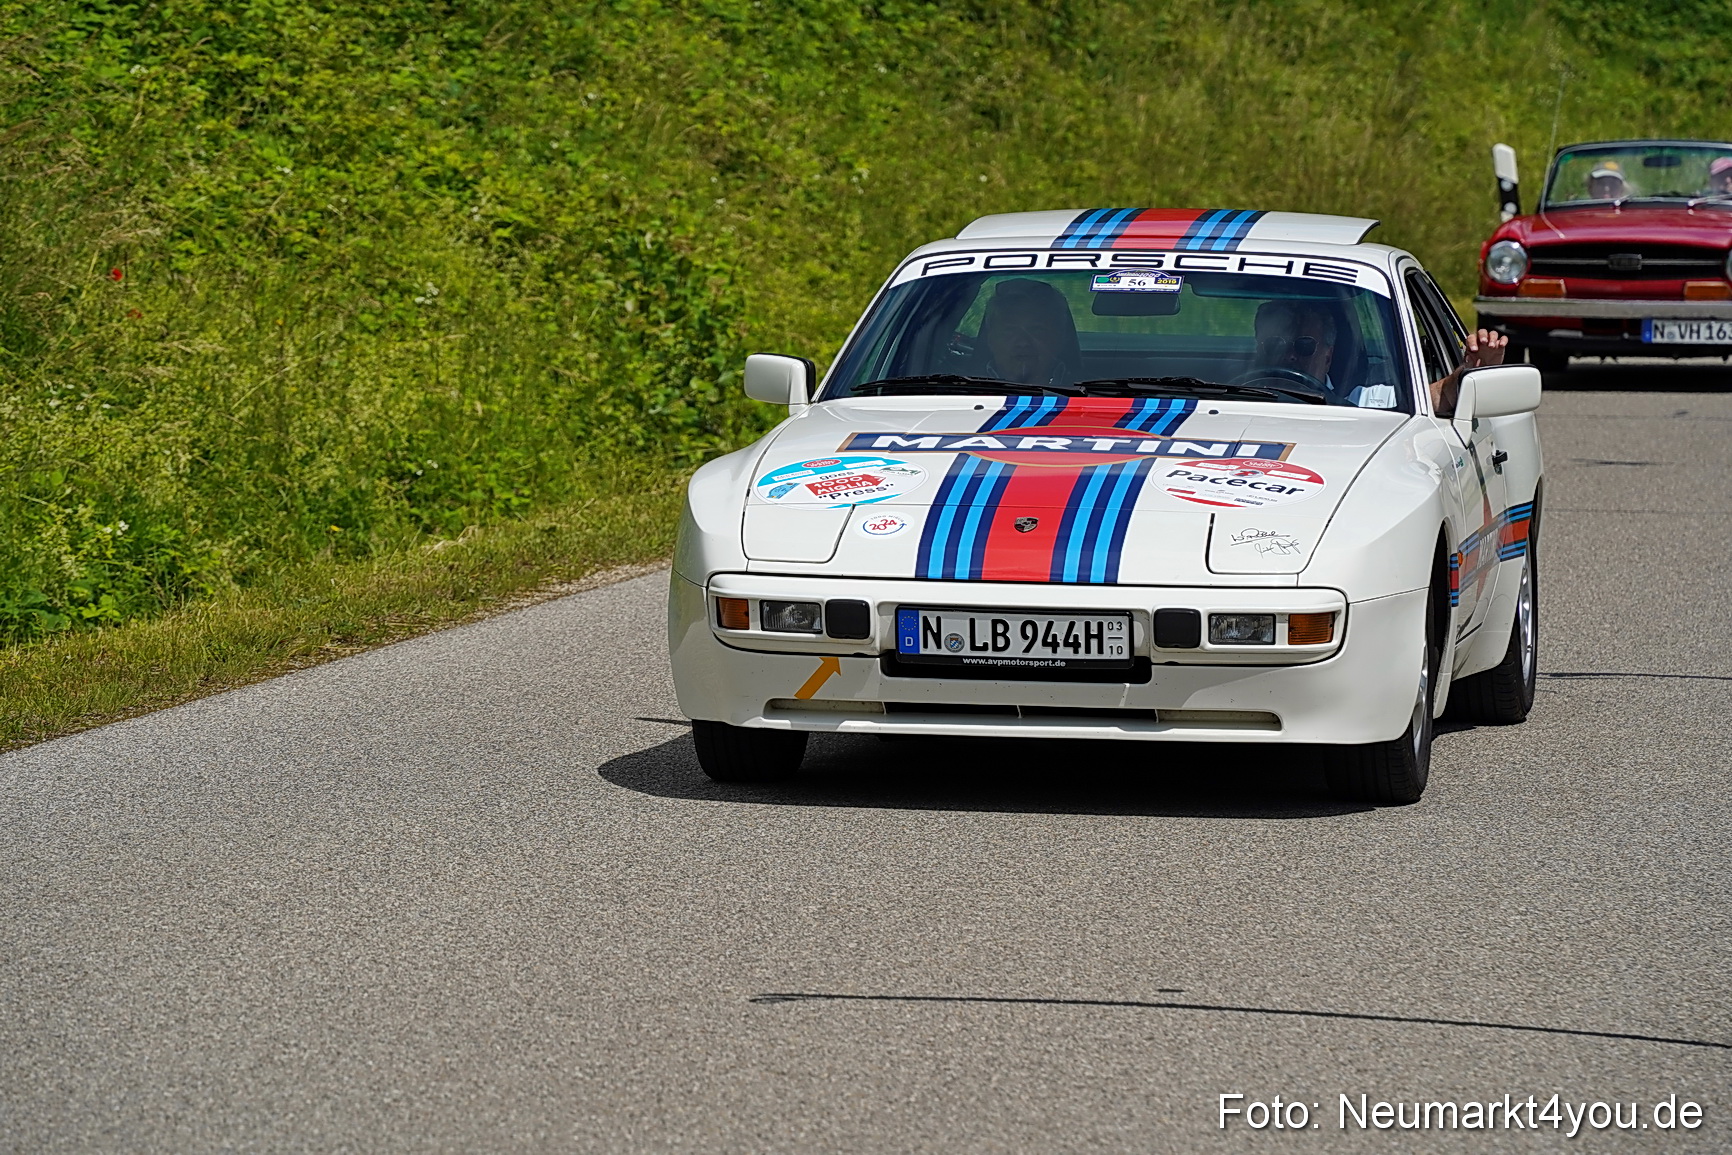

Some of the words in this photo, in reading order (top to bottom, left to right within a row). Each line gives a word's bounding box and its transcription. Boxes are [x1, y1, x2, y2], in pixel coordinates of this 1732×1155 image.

[921, 252, 1358, 284] PORSCHE
[1128, 278, 1146, 287] 56
[1653, 322, 1665, 340] N
[1677, 322, 1701, 341] VH
[869, 434, 1260, 457] MARTINI
[813, 476, 863, 488] 1000
[817, 480, 873, 495] MIGLIA
[1165, 469, 1305, 496] Pacecar
[869, 518, 897, 531] 2024
[1107, 621, 1123, 631] 03
[905, 636, 914, 647] D
[922, 615, 942, 650] N
[969, 617, 1011, 652] LB
[1020, 619, 1104, 655] 944H
[1108, 645, 1123, 655] 10
[962, 657, 1066, 668] www.avpmotorsport.de
